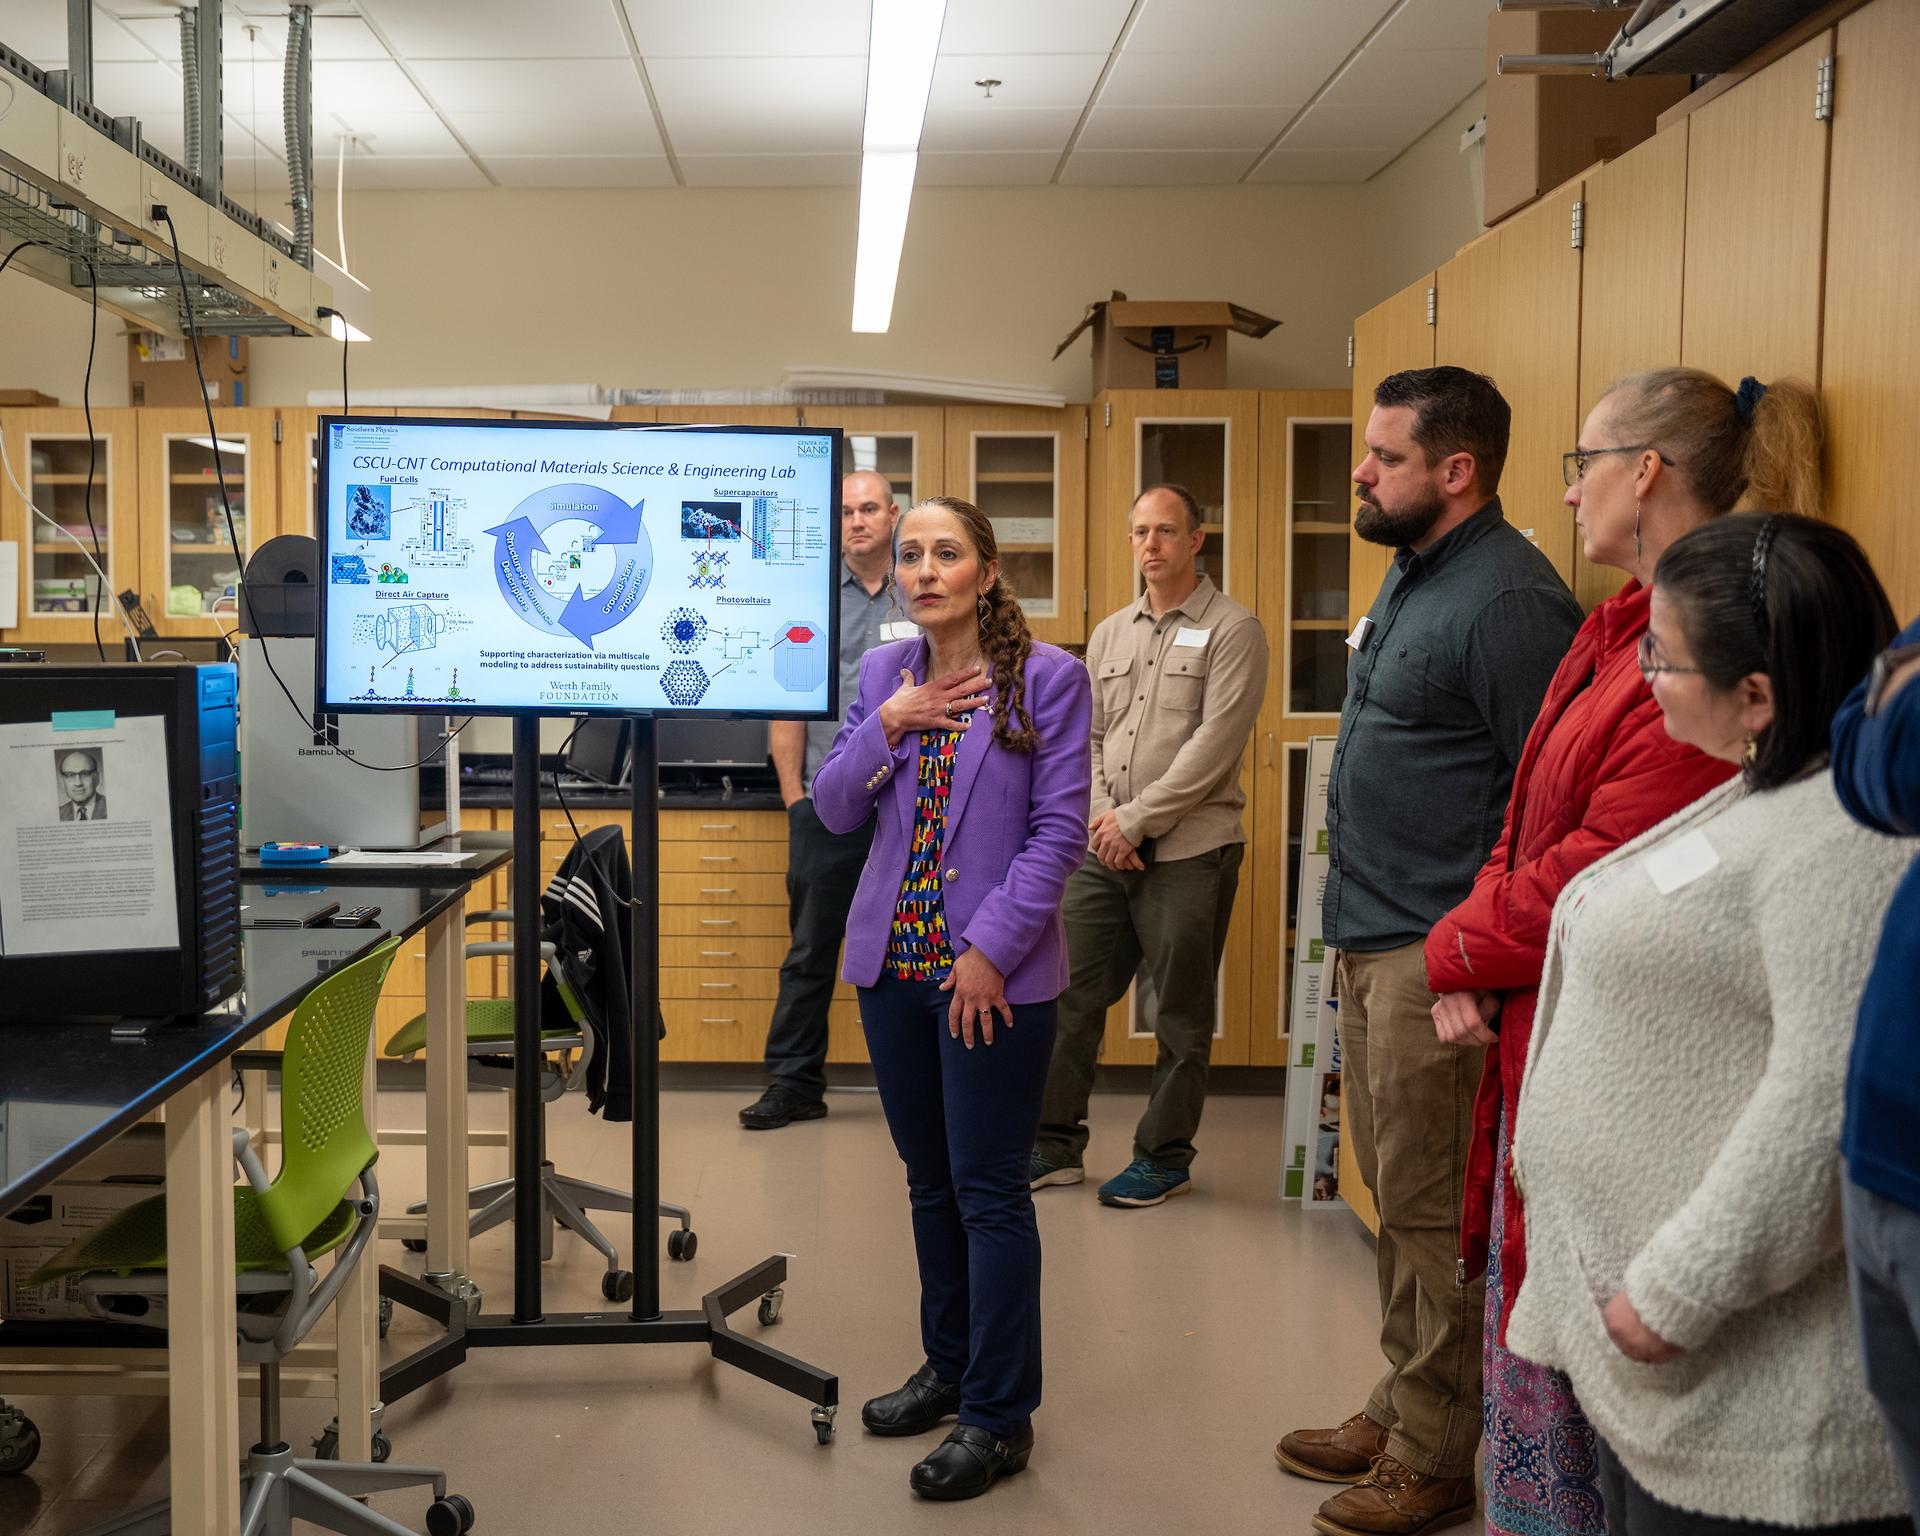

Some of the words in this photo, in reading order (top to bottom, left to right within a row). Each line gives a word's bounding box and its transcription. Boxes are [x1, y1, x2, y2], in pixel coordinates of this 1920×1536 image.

[798, 445, 829, 455] NANO
[353, 456, 427, 471] CSCU-CNT
[430, 458, 537, 474] Computational
[540, 459, 607, 474] Materials
[611, 461, 664, 476] Science
[668, 462, 679, 476] &
[684, 463, 767, 480] Engineering
[771, 465, 796, 479] Lab
[380, 475, 397, 484] Fuel
[399, 476, 419, 484] Cells
[713, 488, 779, 498] Supercapacitors
[548, 502, 599, 512] Simulation
[501, 560, 530, 612] Descriptors
[601, 558, 636, 616] Ground-State
[617, 568, 646, 613] Properties
[375, 590, 401, 599] Direct
[402, 591, 414, 599] Air
[416, 591, 449, 600] Capture
[716, 596, 772, 605] Photovoltaics
[479, 650, 525, 660] Supporting
[527, 650, 592, 660] characterization
[594, 652, 608, 660] via
[610, 652, 650, 661] multiscale
[479, 660, 518, 670] modeling
[520, 661, 529, 669] to
[531, 661, 562, 669] address
[564, 661, 619, 672] sustainability
[620, 663, 660, 672] questions
[550, 681, 578, 691] Werth
[581, 682, 612, 692] Family
[540, 692, 619, 701] FOUNDATION
[298, 748, 334, 756] Bambu
